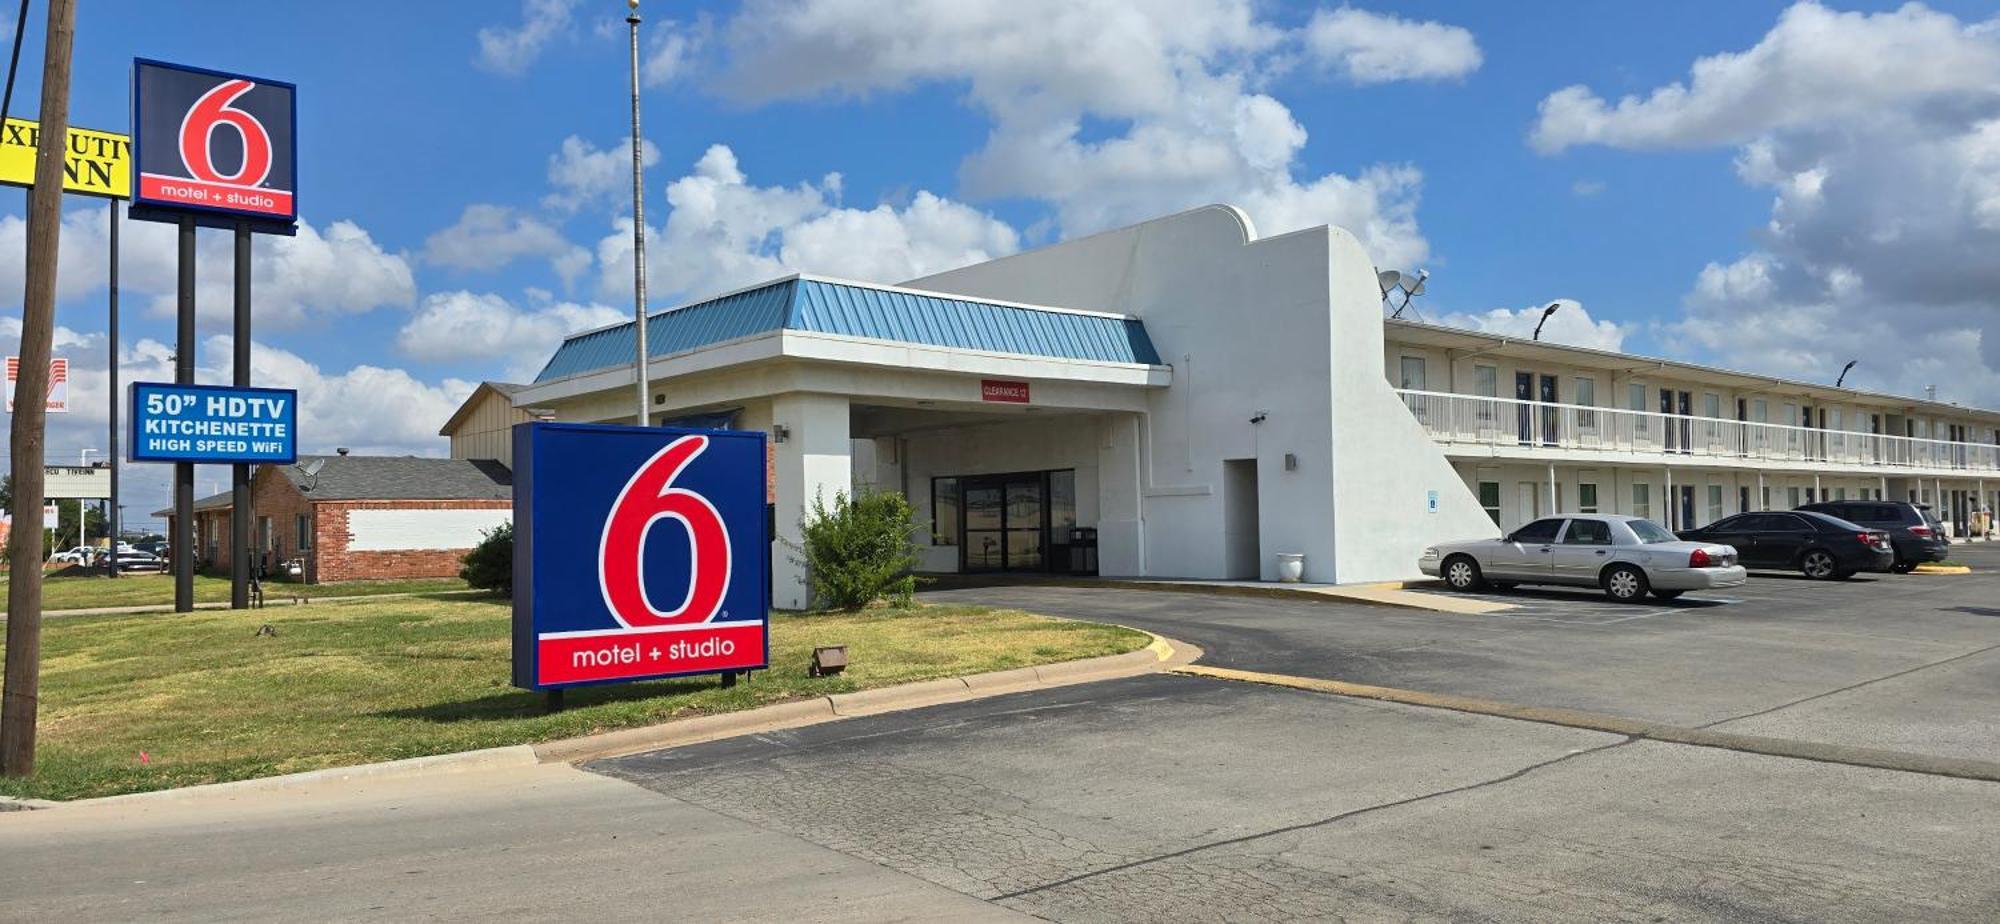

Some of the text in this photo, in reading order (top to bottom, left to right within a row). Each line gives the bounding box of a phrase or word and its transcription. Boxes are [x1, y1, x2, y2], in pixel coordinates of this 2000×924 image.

[179, 79, 272, 187] 6
[63, 157, 113, 188] NN
[161, 185, 274, 208] motel + studio
[207, 396, 285, 419] HDTV
[145, 419, 286, 437] KITCHENETTE
[150, 438, 283, 453] HIGH SPEED WiFi
[598, 434, 732, 629] 6
[573, 637, 735, 668] motel + studio
